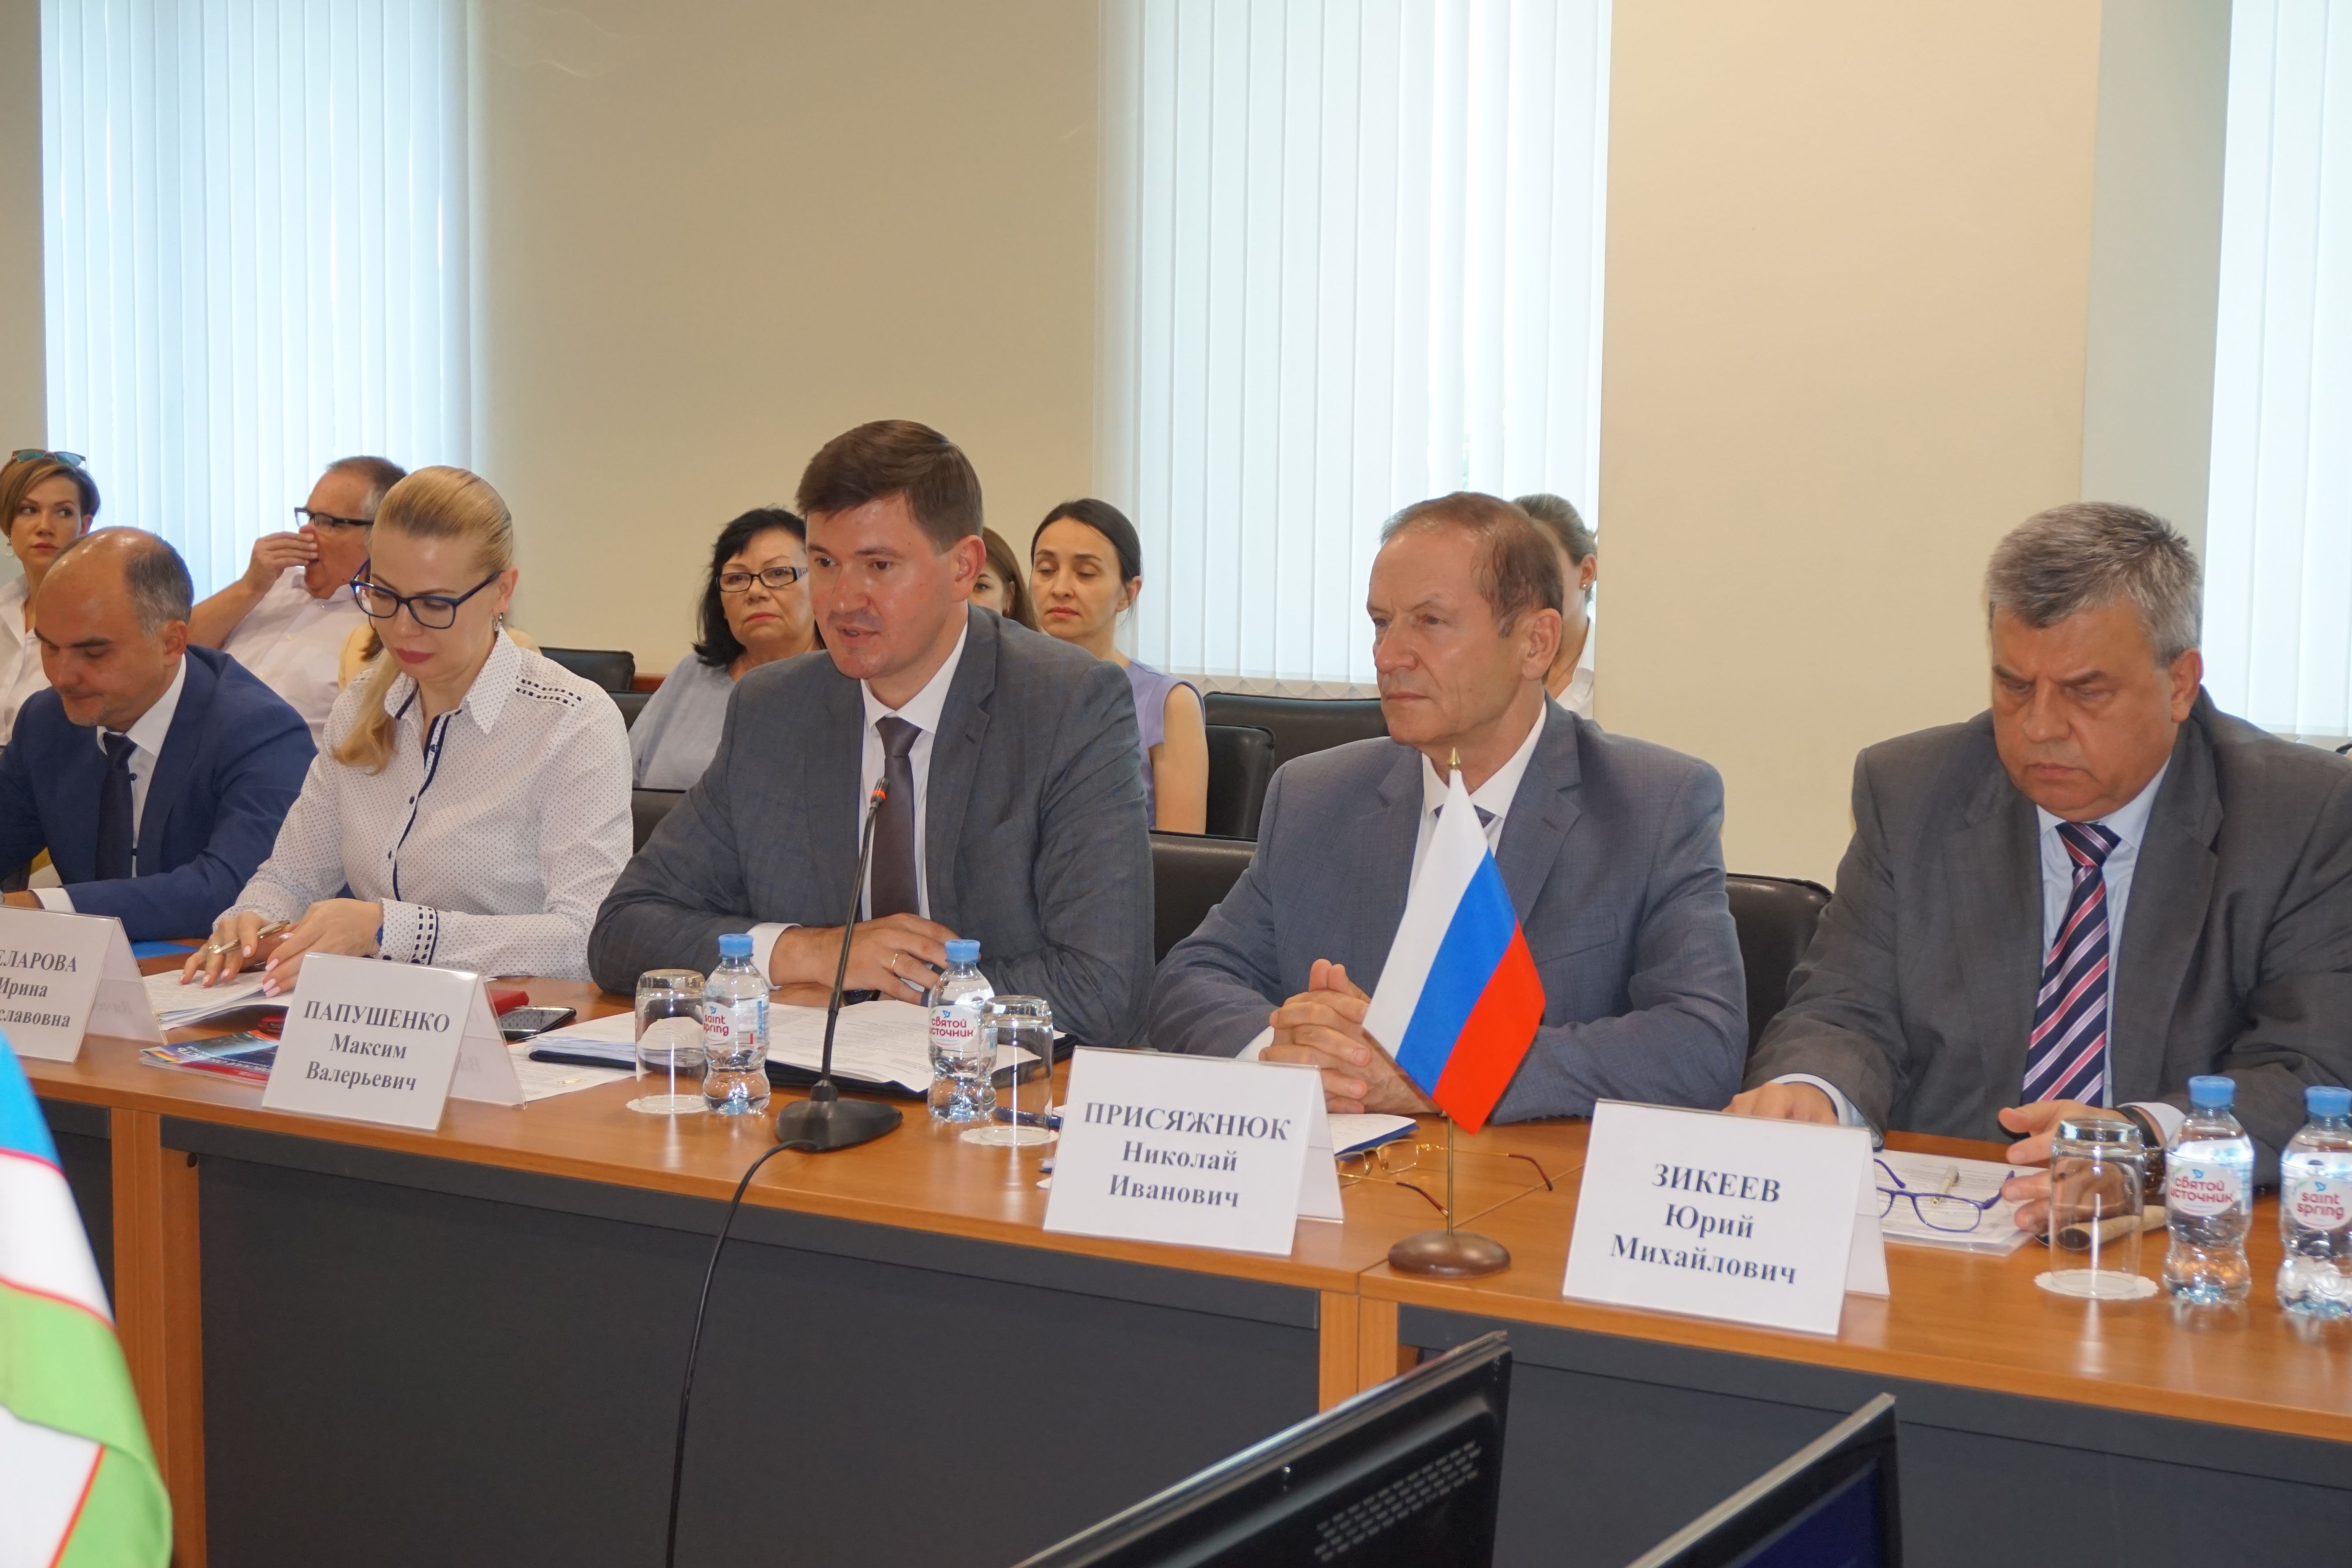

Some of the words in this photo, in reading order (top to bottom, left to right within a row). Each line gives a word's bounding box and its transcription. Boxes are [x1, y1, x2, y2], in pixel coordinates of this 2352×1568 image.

[0, 977, 48, 999] Ирина
[304, 1000, 450, 1033] ПАПУШЕНКО
[704, 1015, 725, 1024] saint
[330, 1033, 408, 1059] Максим
[306, 1061, 417, 1091] Валерьевич
[1085, 1102, 1291, 1141] ПРИСЯЖНЮК
[1122, 1140, 1238, 1172] Николай
[1109, 1174, 1240, 1208] Иванович
[1652, 1163, 1781, 1203] ЗИКЕЕВ
[2302, 1192, 2340, 1204] saint
[1664, 1203, 1754, 1239] Юрий
[2297, 1203, 2344, 1220] spring
[1610, 1234, 1797, 1284] Михайлович
